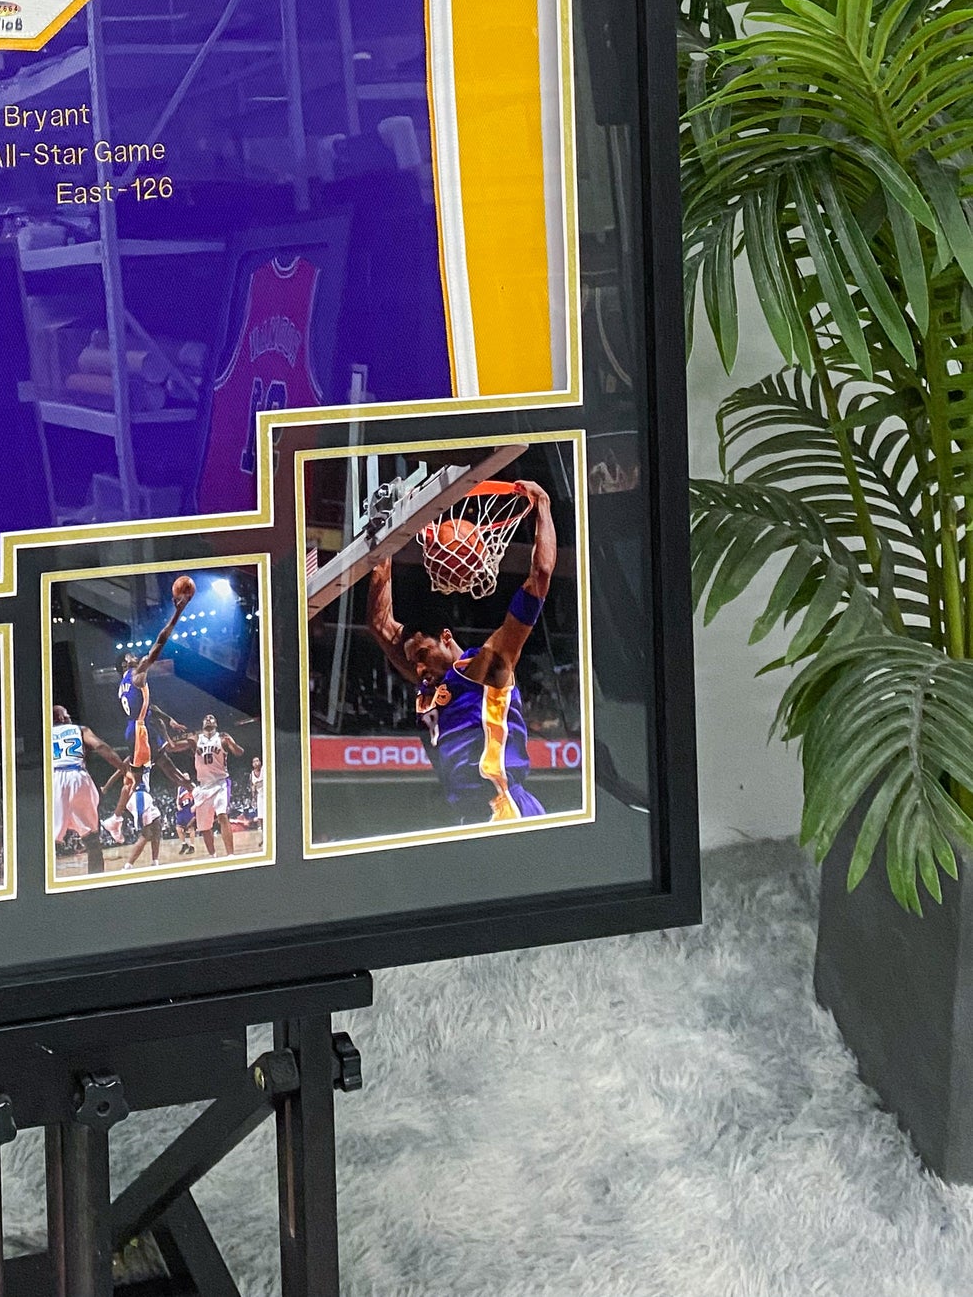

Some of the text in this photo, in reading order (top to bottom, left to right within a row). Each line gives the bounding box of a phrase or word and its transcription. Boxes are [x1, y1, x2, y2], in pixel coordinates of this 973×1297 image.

[3, 104, 91, 132] Bryant
[93, 141, 166, 163] Game
[56, 176, 174, 205] East-126
[545, 742, 581, 768] TO
